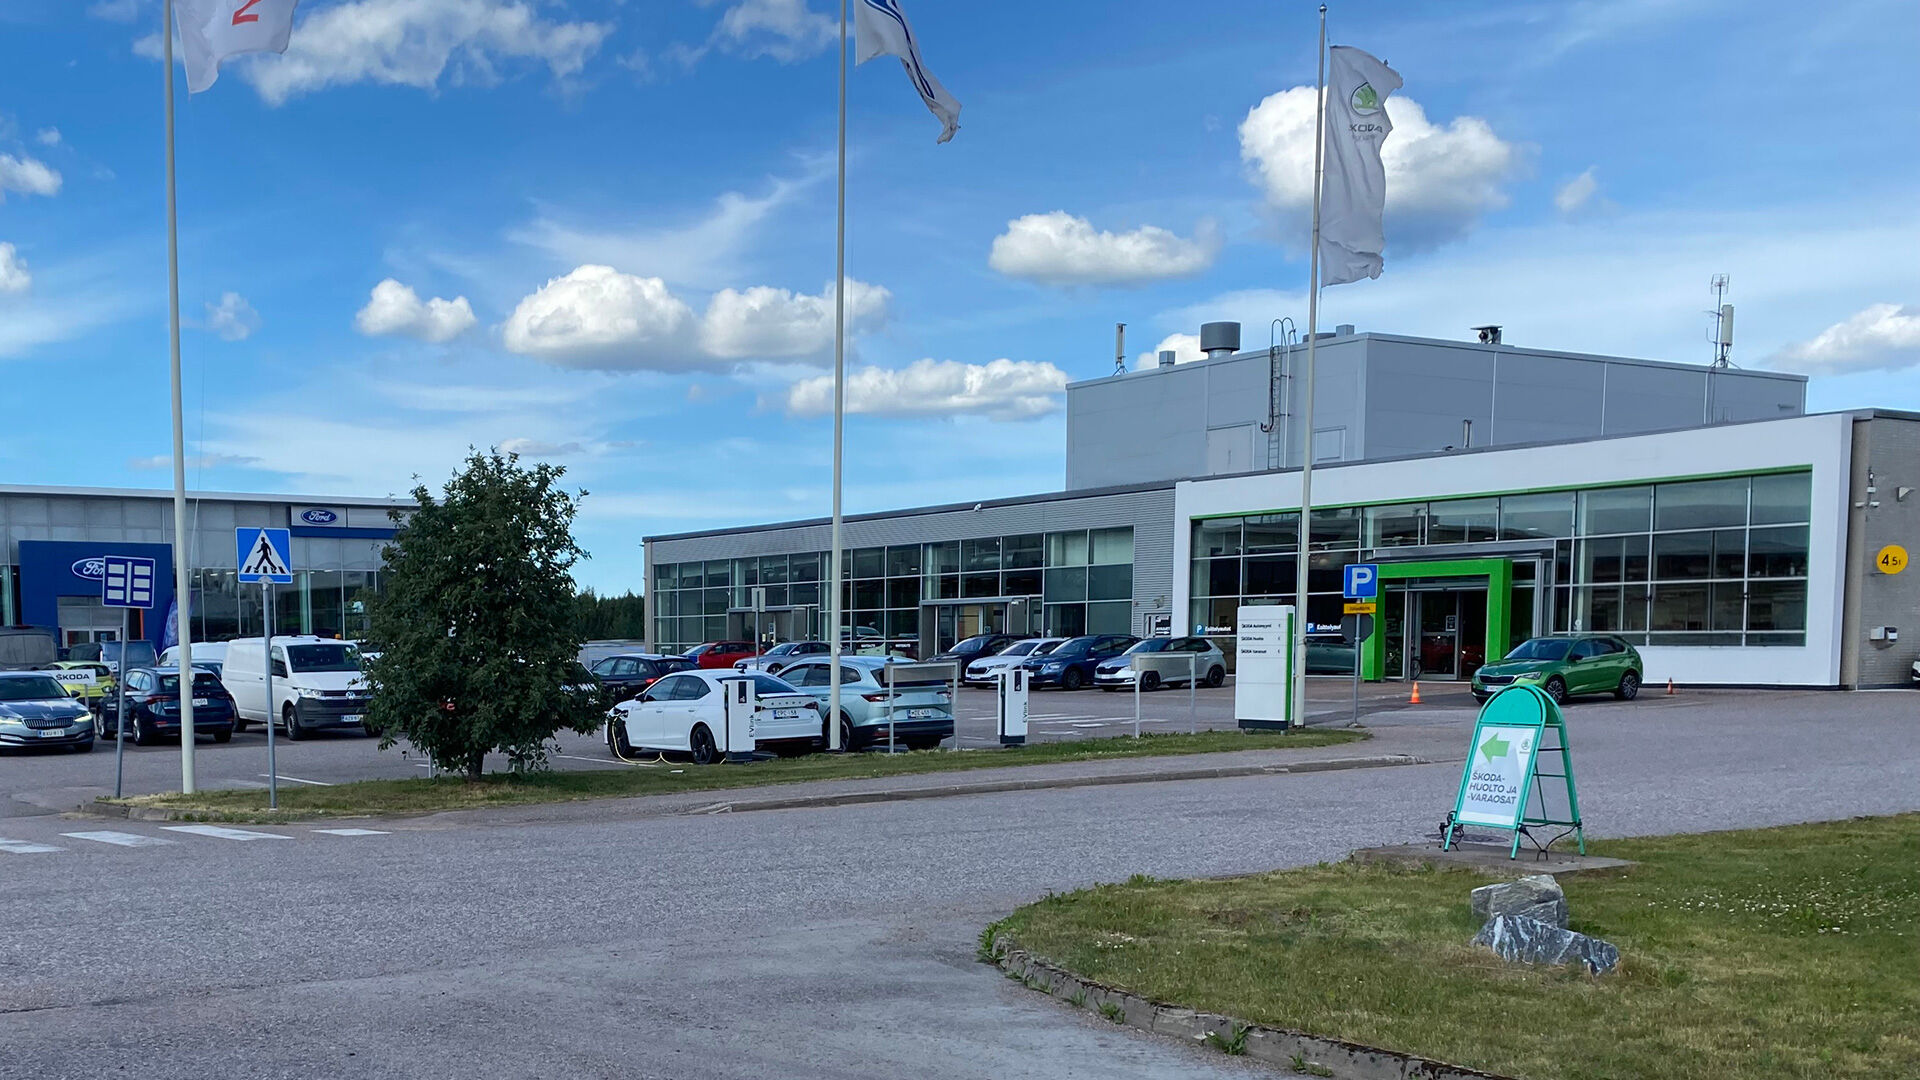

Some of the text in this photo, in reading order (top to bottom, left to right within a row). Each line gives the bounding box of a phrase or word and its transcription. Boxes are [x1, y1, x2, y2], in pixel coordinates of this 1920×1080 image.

[308, 510, 332, 521] Ford
[82, 560, 104, 575] Fo
[1351, 567, 1373, 596] P
[1469, 782, 1518, 795] HUOLTO JA
[1466, 792, 1518, 805] -VARAOSAT
